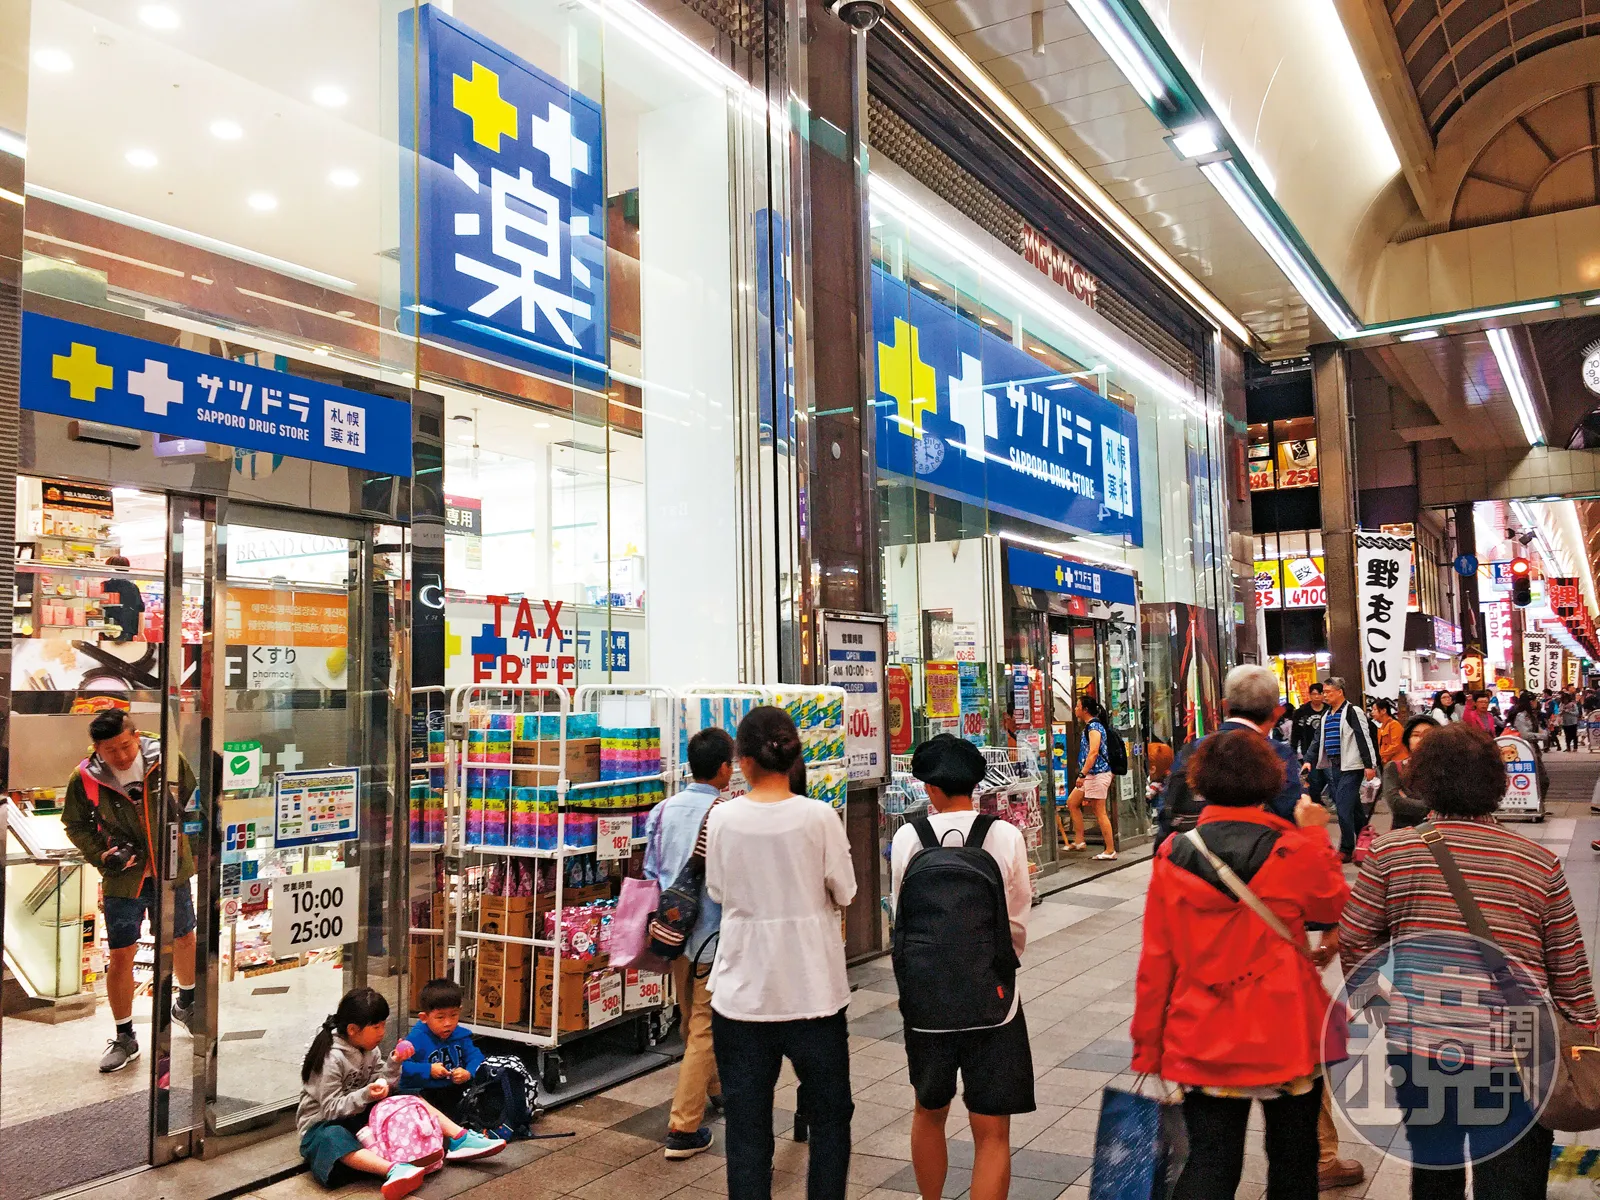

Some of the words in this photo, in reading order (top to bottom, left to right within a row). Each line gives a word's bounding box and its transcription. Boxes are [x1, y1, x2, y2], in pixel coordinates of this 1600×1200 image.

[197, 373, 310, 423] サツドラ
[197, 407, 245, 429] SAPPORO
[249, 418, 276, 435] DRUG
[279, 424, 310, 442] STORE
[330, 407, 359, 428] 札幌
[1006, 380, 1093, 467] サツドラ
[330, 427, 360, 447] 薬粧
[1009, 447, 1048, 482] SAPPORO
[1049, 462, 1071, 491] DRUG
[1072, 472, 1095, 500] STORE
[1286, 467, 1319, 486] 258
[446, 508, 473, 528] 専用
[486, 595, 563, 639] TAX
[252, 646, 296, 664] くすり
[845, 651, 860, 660] OPEN
[252, 670, 294, 679] pharmacy
[474, 654, 577, 696] FREE
[833, 666, 843, 676] AM
[845, 665, 865, 676] 10:00
[844, 683, 864, 692] CLOSED
[848, 709, 869, 737] :00
[226, 823, 256, 851] JCB
[612, 836, 628, 849] 187
[283, 880, 313, 892] 営業時間
[292, 886, 344, 914] 10:00
[290, 915, 343, 945] 25:00
[640, 983, 658, 998] 380
[602, 994, 618, 1013] 380
